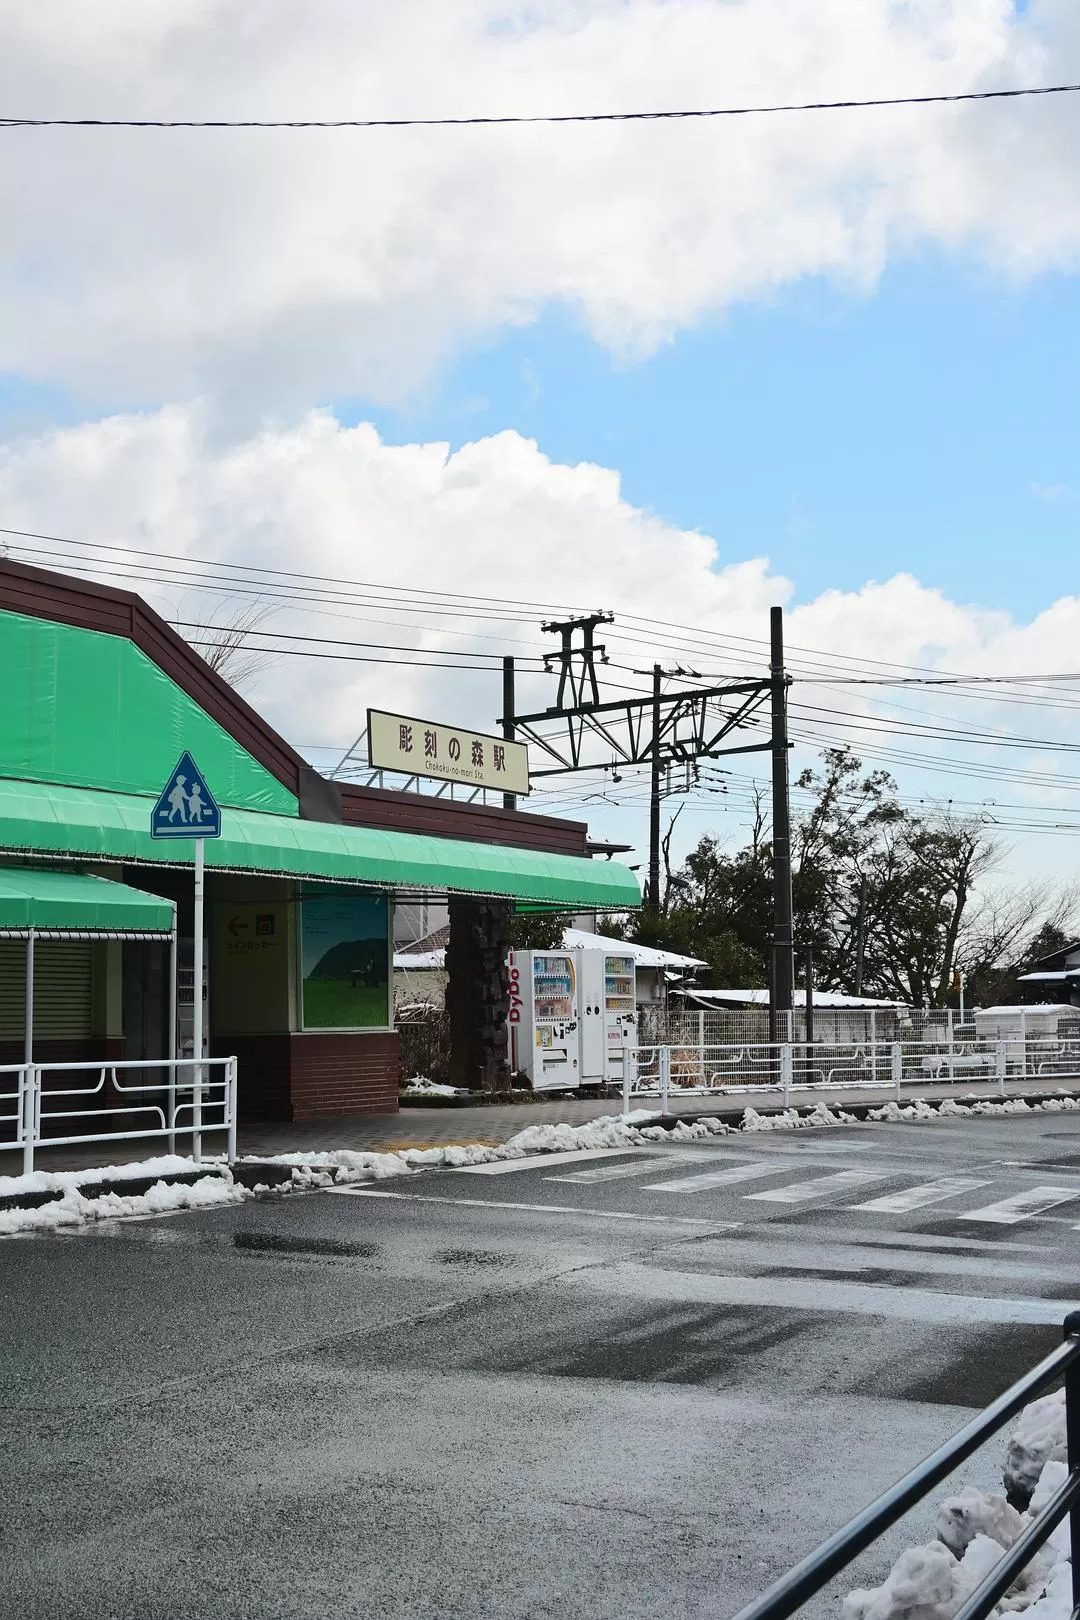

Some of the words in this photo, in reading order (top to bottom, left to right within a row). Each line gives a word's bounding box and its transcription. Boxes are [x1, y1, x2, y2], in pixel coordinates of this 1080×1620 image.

[399, 724, 506, 771] 彫刻の森駅
[509, 968, 523, 1022] DyDo
